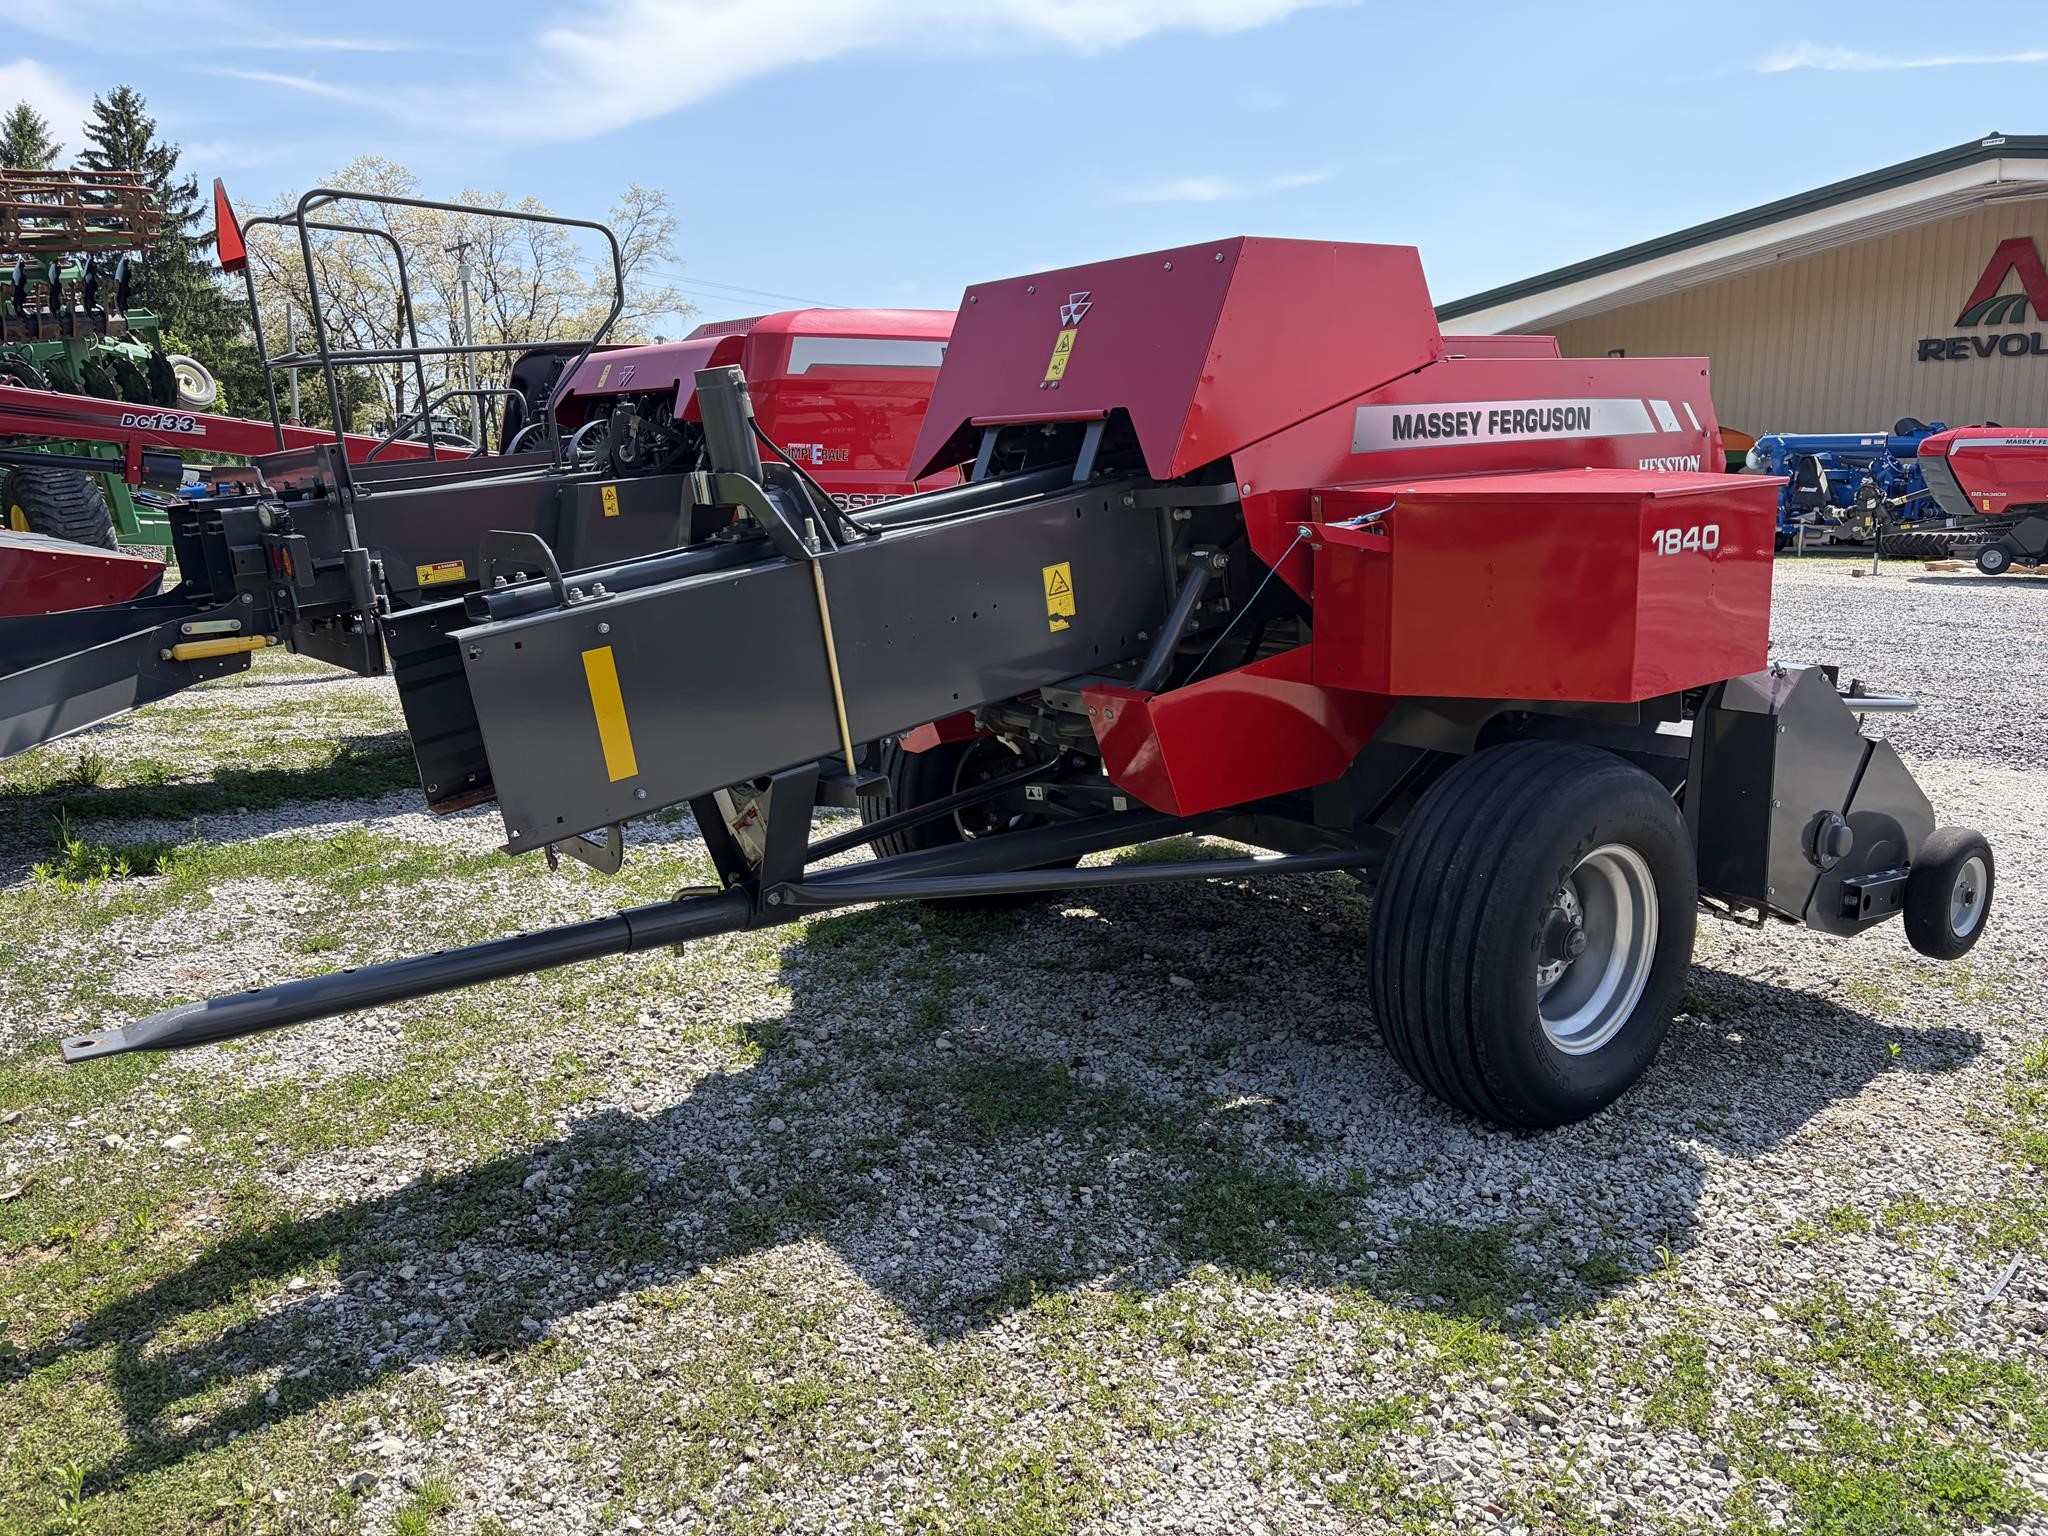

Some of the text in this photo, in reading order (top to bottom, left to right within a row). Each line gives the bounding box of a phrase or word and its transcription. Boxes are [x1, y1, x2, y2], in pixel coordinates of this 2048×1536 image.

[120, 413, 196, 431] DC133
[1392, 406, 1591, 440] MASSEY FERGUSON
[1651, 524, 1720, 556] 1840
